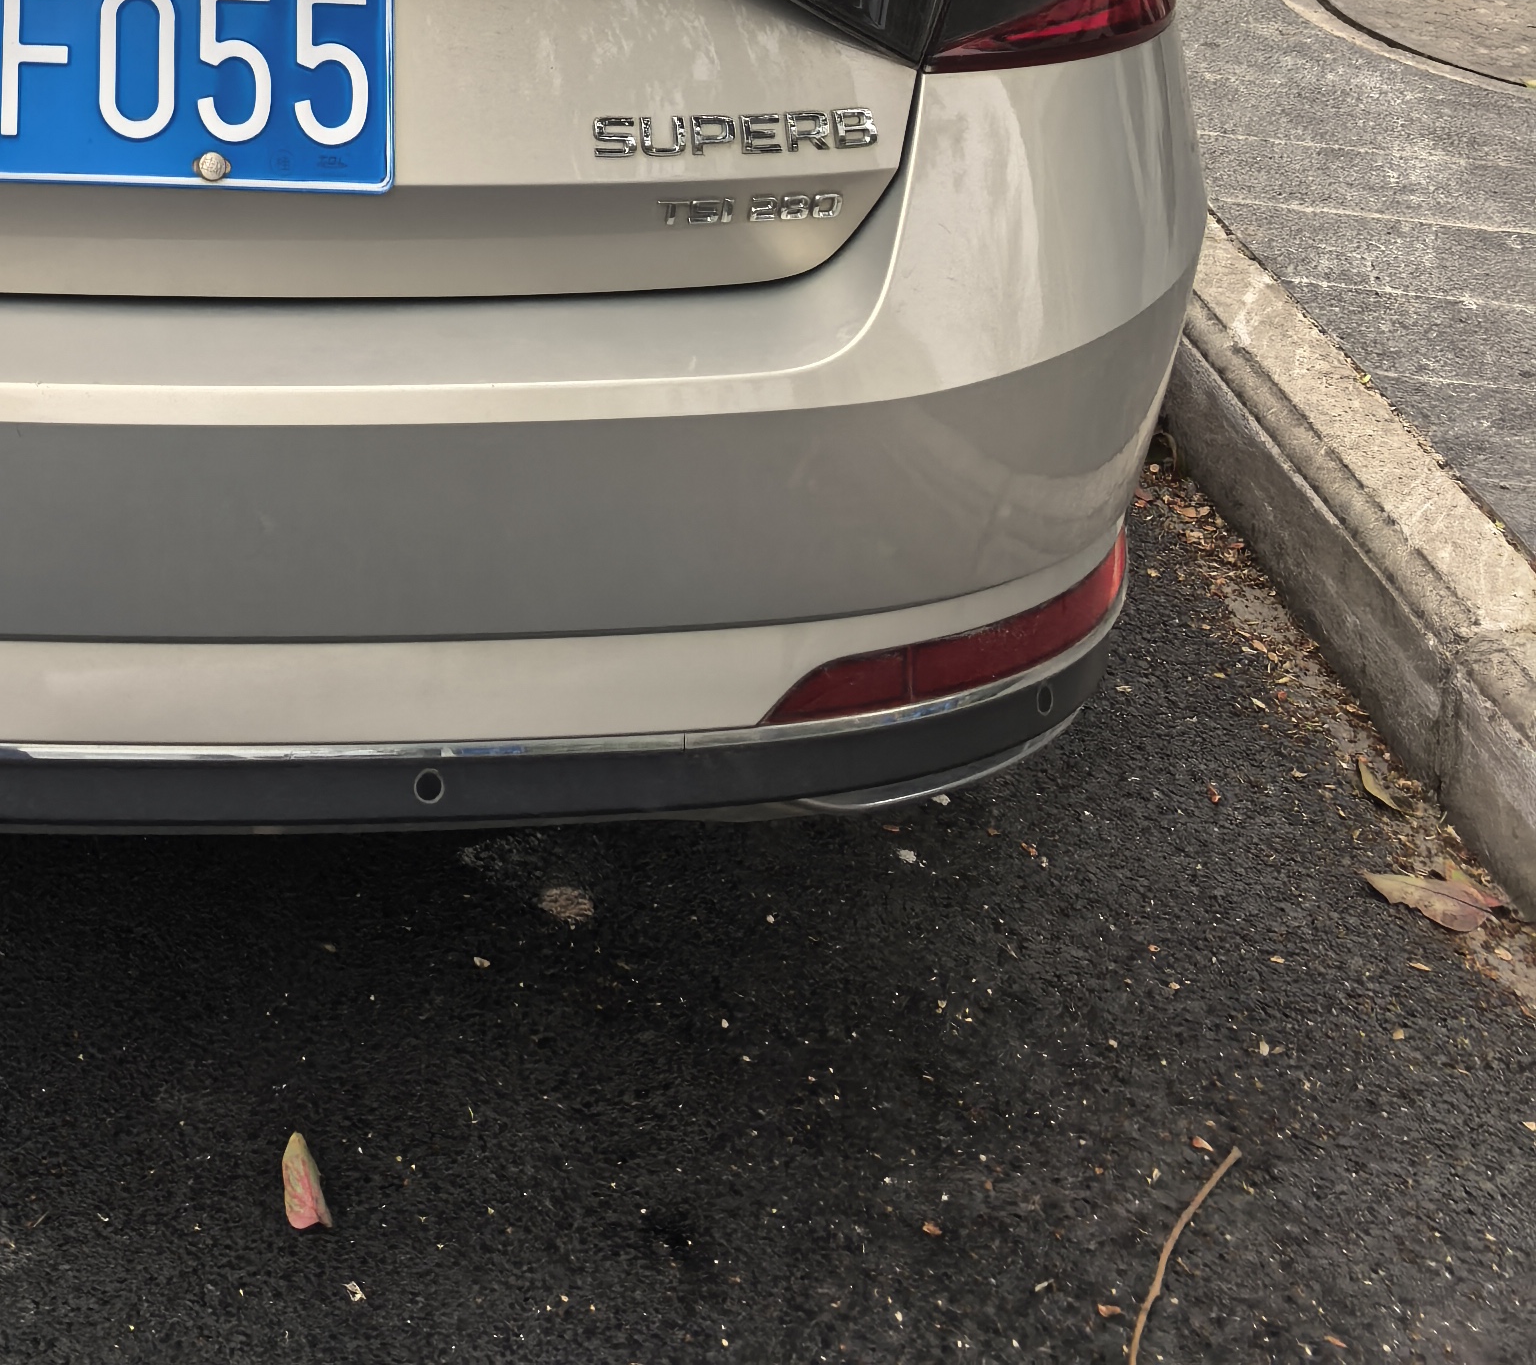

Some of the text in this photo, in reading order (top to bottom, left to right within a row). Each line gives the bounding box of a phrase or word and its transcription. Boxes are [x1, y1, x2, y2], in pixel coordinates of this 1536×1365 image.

[593, 107, 879, 158] SUPERB
[657, 192, 844, 225] TSI 280
